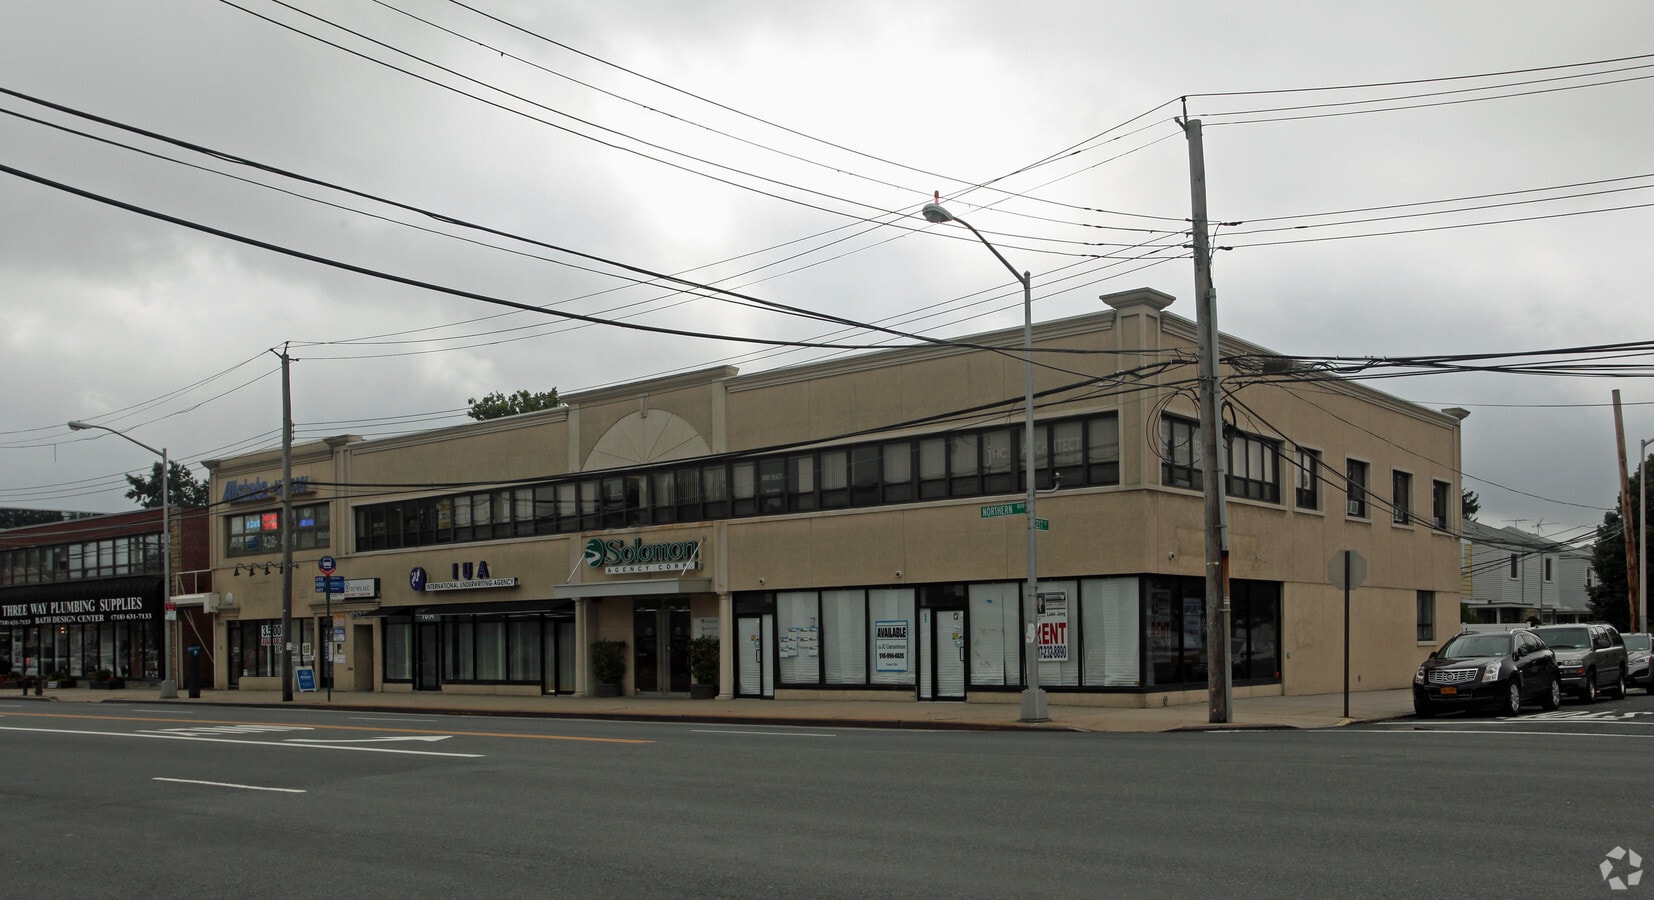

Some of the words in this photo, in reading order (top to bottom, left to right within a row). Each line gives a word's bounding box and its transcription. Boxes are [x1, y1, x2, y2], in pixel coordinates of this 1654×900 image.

[1021, 436, 1081, 457] ACHITECT
[982, 504, 1013, 517] NORTHERN
[605, 538, 698, 564] Solomon
[452, 561, 490, 580] IUA
[607, 565, 650, 573] AGENCY
[426, 581, 459, 590] INTERNATIONAL
[459, 580, 493, 588] UNDERWRITING
[493, 578, 514, 586] AGENCY
[2, 604, 28, 617] THREE
[30, 602, 48, 615] WAY
[50, 599, 96, 614] PLUMBING
[99, 596, 143, 612] SUPPLIES
[35, 616, 52, 625] BATH
[52, 615, 76, 623] DESIGN
[77, 614, 105, 623] CENTER
[110, 613, 125, 621] (718)
[126, 612, 152, 620] 631-7133
[877, 627, 907, 638] AVAILABLE
